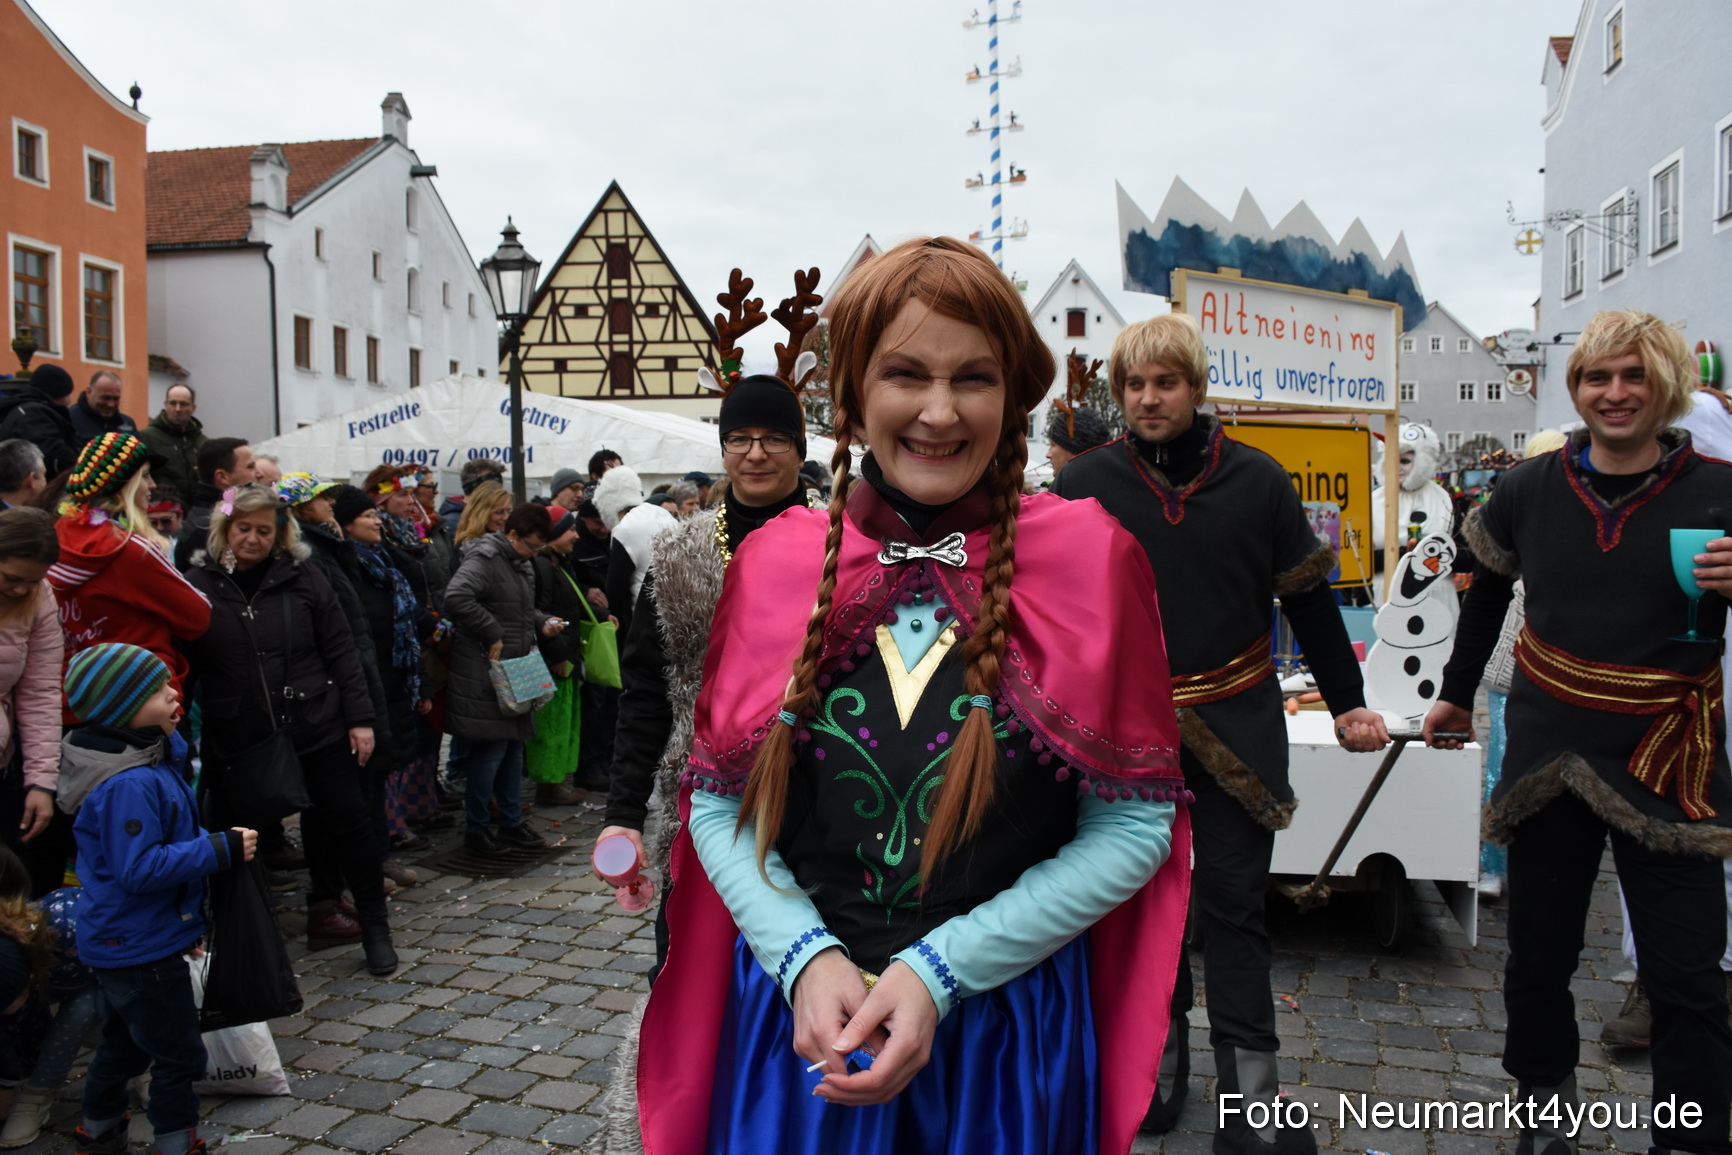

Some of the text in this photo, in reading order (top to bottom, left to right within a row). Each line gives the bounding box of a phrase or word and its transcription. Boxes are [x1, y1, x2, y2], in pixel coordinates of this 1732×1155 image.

[1201, 291, 1375, 360] Altneiening
[1205, 346, 1385, 402] öllig unverfroren
[347, 398, 571, 439] Festzelte Gchrey
[383, 448, 439, 467] 09497
[467, 446, 534, 465] 90201
